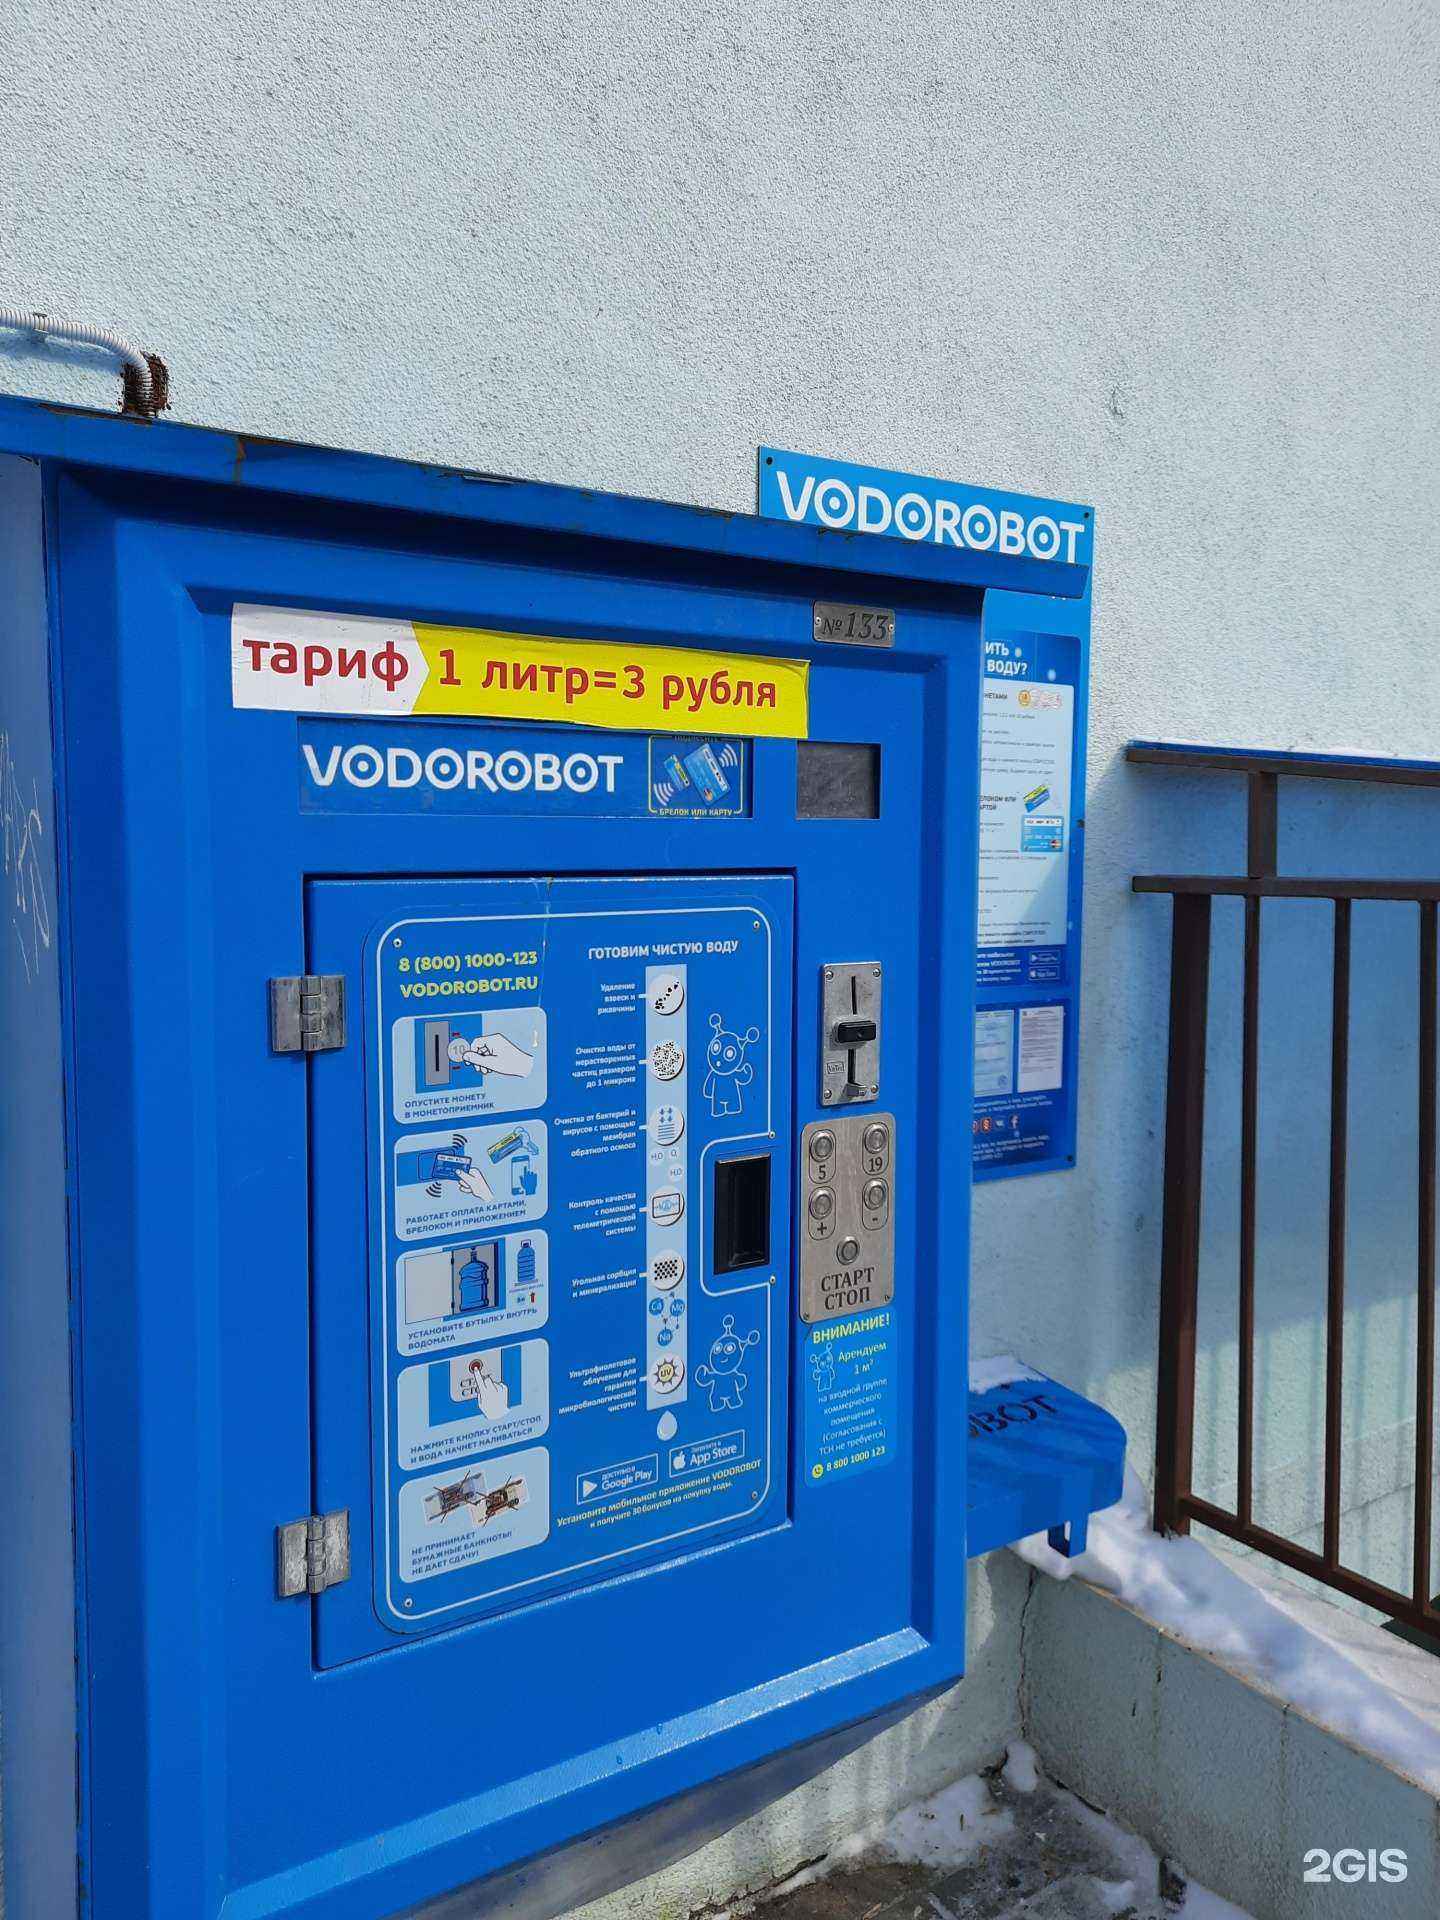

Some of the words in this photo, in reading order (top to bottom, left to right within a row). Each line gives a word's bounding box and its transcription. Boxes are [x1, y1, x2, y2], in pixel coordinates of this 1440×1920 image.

[776, 471, 1085, 563] VODOROBOT
[822, 617, 842, 635] №
[845, 612, 889, 640] 133
[984, 641, 1010, 656] ИТЬ
[242, 637, 409, 691] тариф
[439, 649, 461, 686] 1
[482, 660, 646, 703] литр=3
[663, 674, 777, 711] рубля
[987, 659, 1028, 676] ВОДУ?
[984, 692, 1008, 700] НЕТАМИ
[302, 743, 623, 793] VODOROBOT
[659, 808, 689, 816] БРЕЛОК
[588, 944, 650, 960] ГОТОВИМ
[652, 942, 703, 957] ЧИСТУЮ
[706, 940, 740, 955] ВОДУ
[398, 957, 411, 972] 8
[414, 955, 461, 974] (800)
[465, 951, 538, 969] 1000-123
[400, 976, 538, 998] VODOROBOT.RU
[600, 983, 636, 992] Удаление
[604, 994, 630, 1002] взвеси
[597, 1006, 636, 1016] ржавчины
[576, 1046, 606, 1055] Очистка
[607, 1044, 627, 1053] воды
[575, 1054, 636, 1066] нерастворенных
[572, 1068, 598, 1079] частиц
[599, 1065, 636, 1076] размером
[586, 1081, 596, 1089] до
[603, 1076, 636, 1086] микрона
[405, 1095, 450, 1108] ОПУСТИТЕ
[452, 1093, 487, 1104] МОНЕТУ
[404, 1111, 411, 1119] В
[413, 1103, 495, 1118] МОНЕТОПРИЕМНИК
[554, 1115, 585, 1126] Очистка
[595, 1109, 630, 1120] бактерий
[562, 1126, 593, 1137] вирусов
[599, 1120, 636, 1131] помощью
[602, 1131, 636, 1142] мембран
[570, 1145, 609, 1158] обратного
[610, 1142, 636, 1152] осмоса
[818, 1164, 827, 1180] 5
[868, 1156, 883, 1172] 19
[568, 1198, 604, 1210] Контроль
[605, 1193, 636, 1204] качества
[600, 1203, 636, 1215] помощью
[406, 1211, 449, 1225] РАБОТАЕТ
[451, 1206, 485, 1217] ОПЛАТА
[406, 1221, 453, 1235] БРЕЛОКОМ
[462, 1209, 527, 1226] ПРИЛОЖЕНИЕМ
[573, 1214, 636, 1231] телеметрической
[605, 1225, 636, 1237] системы
[572, 1275, 606, 1287] Угольная
[607, 1268, 637, 1280] сорбция
[821, 1266, 875, 1292] СТАРТ
[579, 1280, 637, 1297] минерализация
[825, 1287, 870, 1310] СТОП
[408, 1324, 464, 1340] УСТАНОВИТЕ
[465, 1313, 504, 1328] БУТЫЛКУ
[506, 1308, 538, 1319] ВНУТРЬ
[813, 1313, 890, 1344] ВНИМАНИЕ!
[408, 1334, 456, 1350] ВОДОМАТА
[838, 1342, 887, 1363] Арендуем
[569, 1357, 637, 1379] Ультрафиолетовое
[583, 1372, 622, 1387] облучение
[623, 1368, 637, 1379] для
[660, 1369, 672, 1377] UV
[855, 1364, 860, 1375] 1
[604, 1379, 637, 1392] гарантии
[818, 1394, 828, 1404] на
[829, 1385, 861, 1400] входной
[863, 1378, 888, 1393] группе
[558, 1390, 637, 1414] микробиологической
[608, 1400, 637, 1413] чистоты
[824, 1394, 882, 1415] коммерческого
[830, 1407, 875, 1426] помещения
[969, 1394, 1057, 1438] BOT
[410, 1436, 454, 1454] НАЖМИТЕ
[456, 1428, 490, 1443] КНОПКУ
[492, 1415, 541, 1434] СТАРТ/СТОП
[819, 1445, 834, 1456] ТСН
[835, 1442, 845, 1451] не
[847, 1429, 886, 1448] требуется)
[418, 1450, 443, 1463] ВОДА
[445, 1441, 477, 1456] НАЧНЕТ
[690, 1453, 711, 1467] App
[712, 1445, 737, 1459] Store
[826, 1462, 832, 1471] 8
[833, 1456, 849, 1469] 800
[851, 1450, 870, 1463] 1000
[872, 1446, 885, 1457] 123
[602, 1475, 633, 1490] Google
[635, 1470, 652, 1482] Play
[557, 1506, 607, 1527] Установите
[608, 1491, 657, 1512] мобильное
[658, 1476, 711, 1497] приложение
[712, 1459, 761, 1481] VODOROBOT
[596, 1510, 631, 1527] получите
[642, 1498, 672, 1511] бонусов
[672, 1496, 682, 1504] на
[683, 1487, 712, 1501] покупку
[411, 1547, 423, 1556] НЕ
[425, 1532, 476, 1551] ПРИНИМАЕТ
[411, 1546, 462, 1566] БУМАЖНЫЕ
[411, 1567, 423, 1576] НЕ
[424, 1560, 446, 1574] ДАЕТ
[448, 1550, 479, 1565] СДАЧУ!
